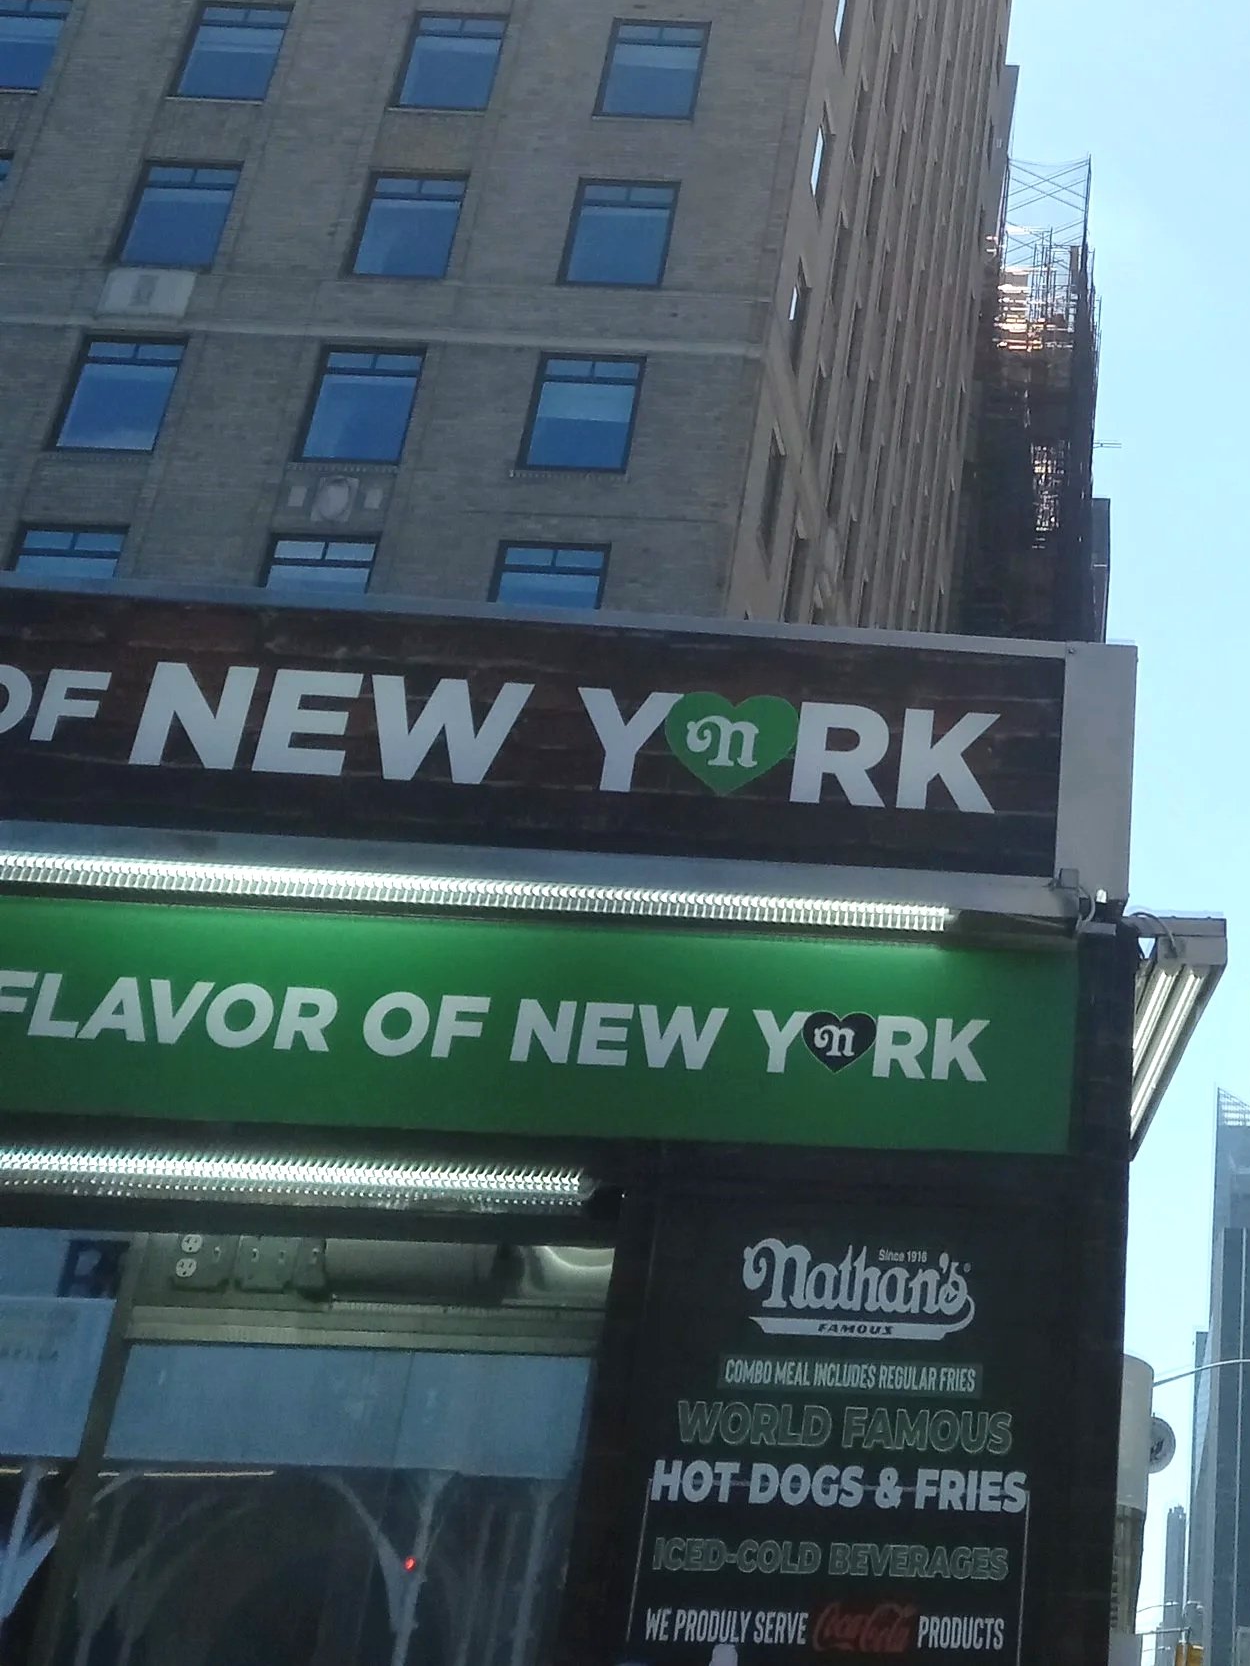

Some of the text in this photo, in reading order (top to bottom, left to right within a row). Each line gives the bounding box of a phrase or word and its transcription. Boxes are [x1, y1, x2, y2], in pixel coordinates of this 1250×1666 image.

[127, 661, 536, 785] NEW
[363, 991, 491, 1058] OF
[509, 998, 730, 1070] NEW
[743, 1237, 975, 1317] Nathan's
[878, 1248, 928, 1263] Since 1916
[817, 1322, 895, 1335] FAMOUS
[725, 1359, 977, 1393] COMBO MEAL INCLUDES REGULAR FRIES
[678, 1400, 1013, 1455] WORLD FAMOUS
[650, 1458, 1028, 1514] HOT DOGS & FRIES
[652, 1536, 1010, 1581] ICED-COLD BEVERAGES
[645, 1606, 673, 1642] WE
[752, 1611, 810, 1646] SERVE
[916, 1614, 1006, 1651] PRODUCTS
